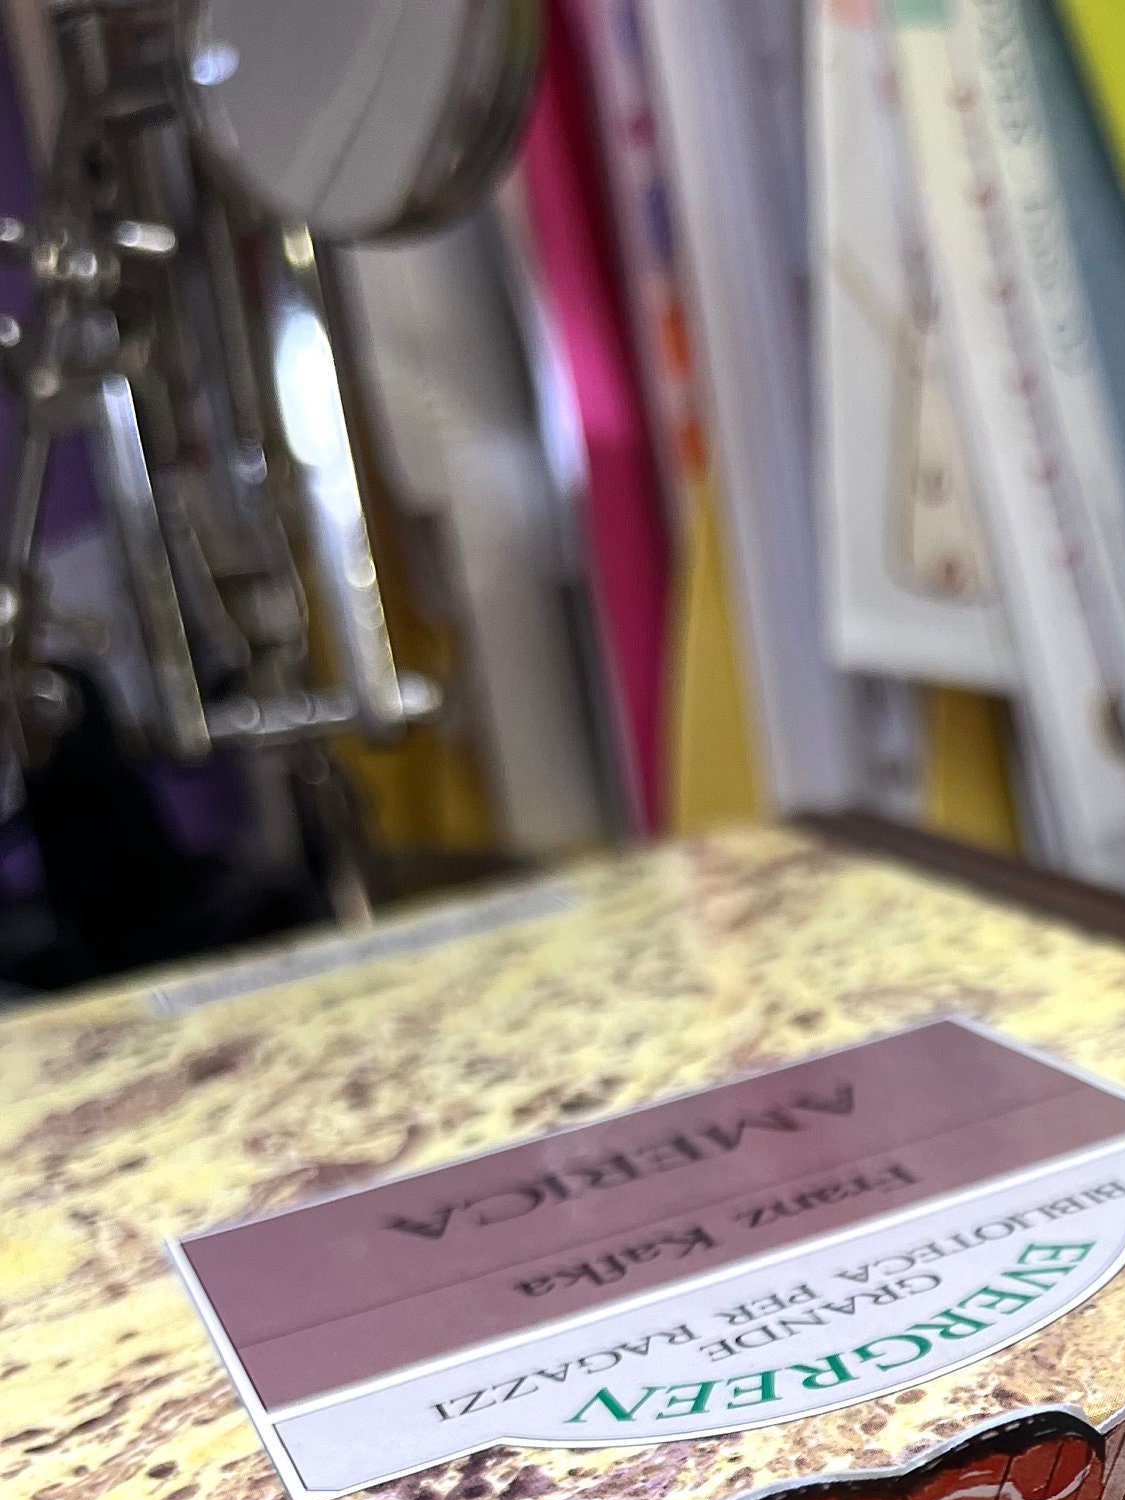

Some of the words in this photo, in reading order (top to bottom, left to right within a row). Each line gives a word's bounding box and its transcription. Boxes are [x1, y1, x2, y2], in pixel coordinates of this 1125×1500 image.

[385, 1082, 855, 1240] AMERICA
[732, 1161, 918, 1229] Franz
[513, 1224, 718, 1298] Kafka
[713, 1282, 820, 1327] PER
[563, 1239, 1097, 1425] EVERGREEN
[698, 1269, 943, 1364] GRANDE
[428, 1322, 705, 1425] RAGAZZI
